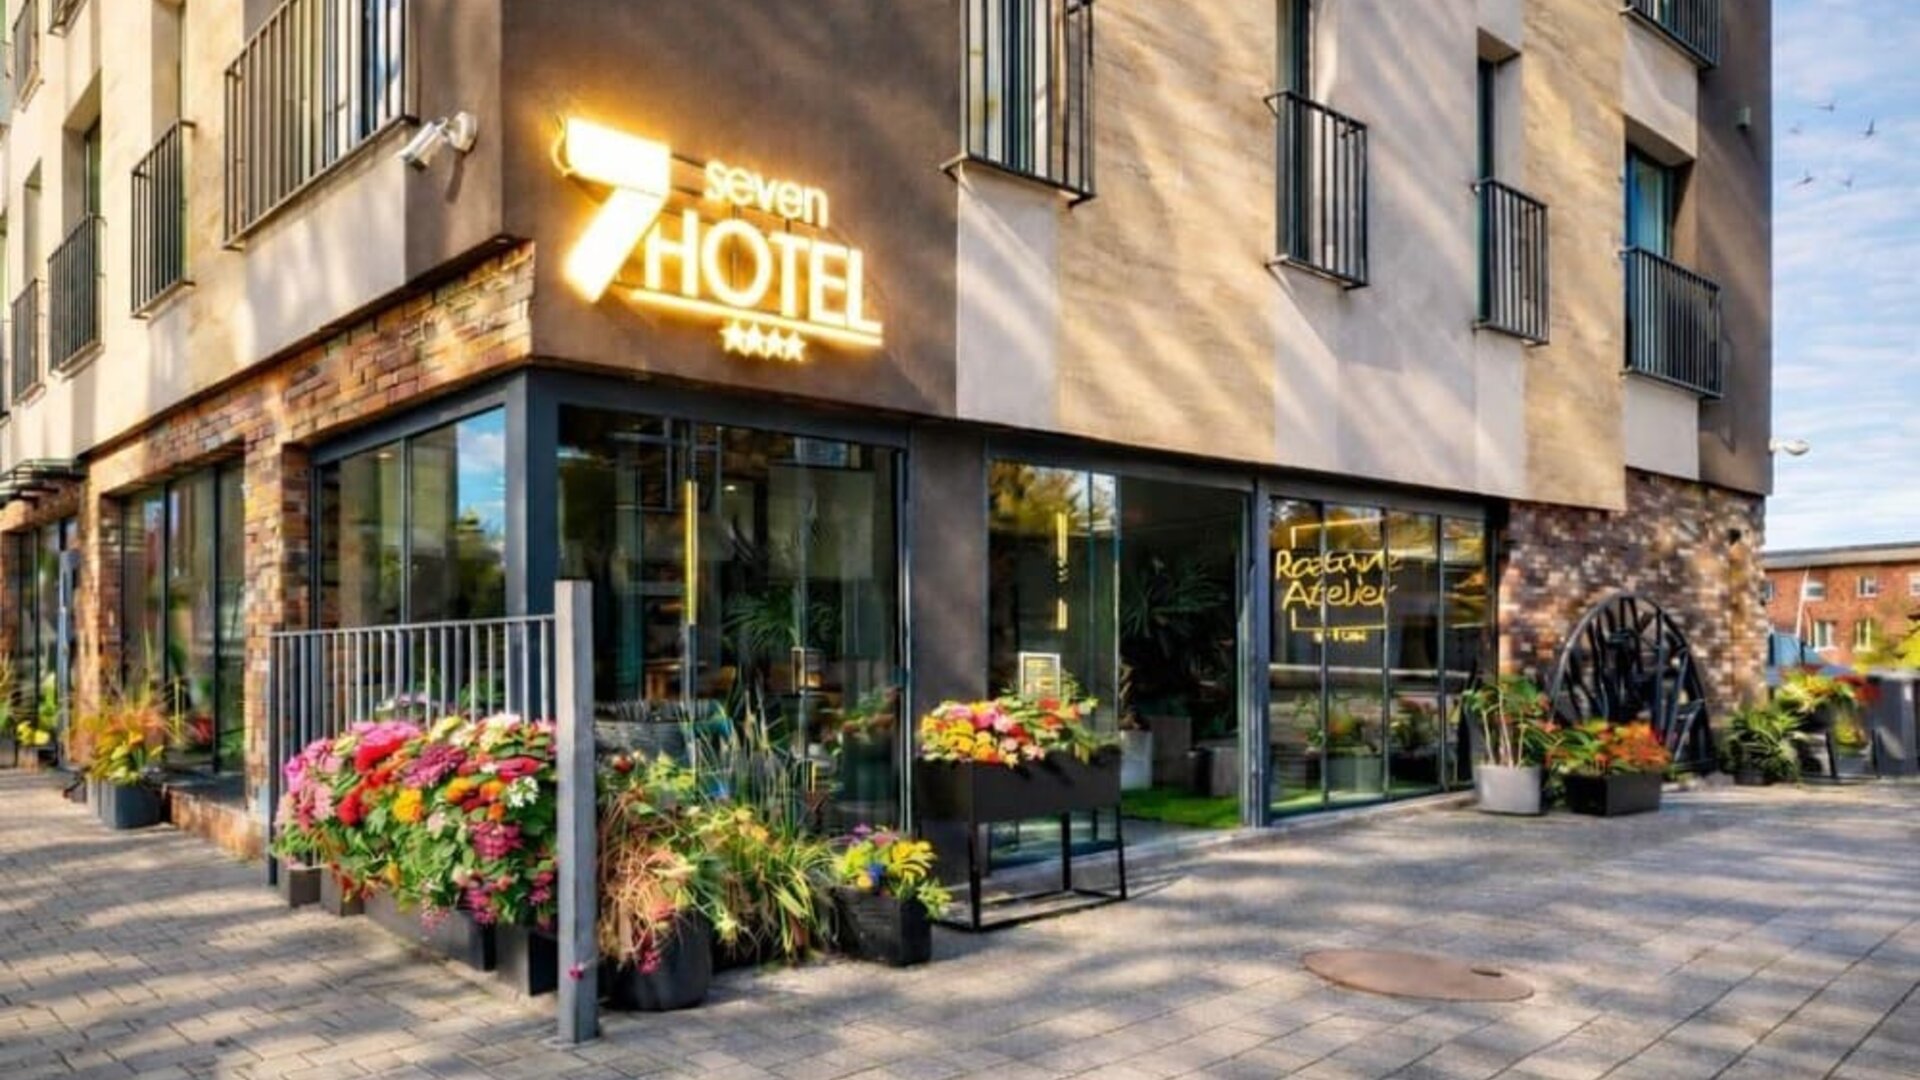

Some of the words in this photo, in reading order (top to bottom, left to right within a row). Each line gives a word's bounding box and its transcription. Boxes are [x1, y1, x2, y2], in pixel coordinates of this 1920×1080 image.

[564, 115, 671, 303] 7
[704, 160, 829, 229] seven
[644, 209, 883, 334] HOTEL
[1281, 577, 1397, 611] Atelier
